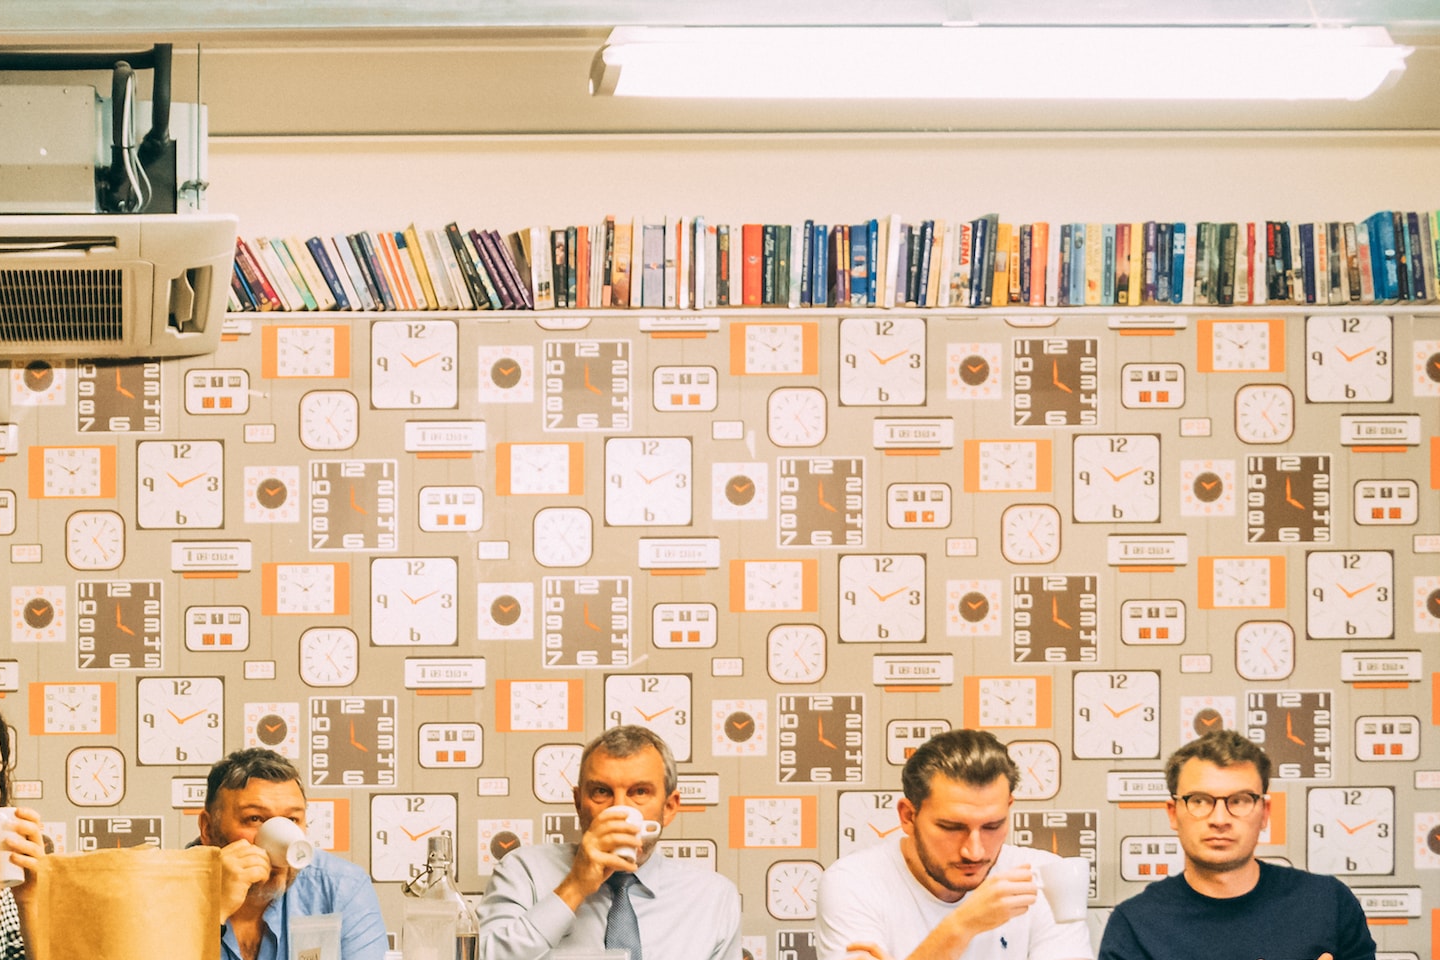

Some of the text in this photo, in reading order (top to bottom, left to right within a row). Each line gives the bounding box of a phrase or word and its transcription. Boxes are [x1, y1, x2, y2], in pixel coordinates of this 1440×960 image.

[960, 225, 971, 265] ARENA
[406, 324, 425, 338] 12
[874, 321, 893, 336] 12
[1341, 318, 1360, 332] 12
[377, 357, 388, 371] 9
[441, 356, 452, 371] 3
[845, 354, 856, 368] 9
[909, 354, 920, 368] 3
[1311, 351, 1322, 365] 9
[1376, 350, 1388, 365] 3
[172, 444, 191, 458] 12
[640, 441, 659, 456] 12
[1108, 438, 1127, 452] 12
[781, 460, 795, 474] 11
[809, 460, 832, 474] 12
[1249, 457, 1263, 471] 11
[1277, 457, 1300, 471] 12
[143, 477, 154, 491] 9
[207, 476, 218, 491] 3
[611, 474, 622, 488] 9
[675, 474, 686, 488] 3
[780, 477, 798, 491] 10
[846, 477, 861, 491] 2
[1079, 471, 1090, 485] 9
[1143, 470, 1154, 485] 3
[1248, 474, 1266, 488] 10
[1313, 474, 1328, 488] 2
[781, 495, 796, 509] 9
[846, 495, 861, 509] 3
[1249, 492, 1264, 506] 9
[1313, 492, 1328, 506] 3
[781, 513, 796, 527] 8
[845, 513, 861, 528] 4
[1249, 510, 1264, 524] 8
[1313, 510, 1329, 524] 4
[781, 530, 797, 544] 7
[810, 530, 832, 544] 6
[845, 530, 861, 544] 5
[1249, 527, 1265, 542] 7
[1278, 527, 1300, 542] 6
[1313, 527, 1329, 542] 5
[406, 561, 425, 576] 12
[874, 558, 893, 572] 12
[1341, 555, 1360, 570] 12
[1015, 577, 1029, 591] 11
[1043, 577, 1066, 591] 12
[845, 591, 856, 605] 9
[909, 590, 920, 605] 3
[1312, 588, 1323, 602] 9
[1377, 586, 1388, 601] 3
[376, 594, 387, 608] 9
[441, 594, 452, 608] 3
[1014, 594, 1032, 608] 10
[1080, 594, 1095, 608] 2
[1015, 612, 1030, 626] 9
[1080, 612, 1095, 626] 3
[1015, 630, 1030, 644] 8
[1080, 630, 1096, 644] 4
[1015, 647, 1031, 662] 7
[1044, 647, 1066, 662] 6
[1080, 647, 1096, 662] 5
[640, 678, 659, 692] 12
[1108, 674, 1127, 688] 12
[172, 681, 191, 696] 12
[313, 700, 327, 714] 11
[341, 700, 364, 714] 12
[1143, 706, 1154, 721] 3
[143, 714, 154, 728] 9
[207, 714, 218, 728] 3
[610, 710, 621, 724] 9
[675, 710, 686, 725] 3
[1079, 708, 1090, 722] 9
[312, 717, 330, 731] 10
[377, 717, 392, 731] 2
[313, 735, 328, 749] 9
[377, 735, 392, 749] 3
[313, 753, 328, 767] 8
[377, 753, 393, 768] 4
[313, 770, 329, 784] 7
[342, 770, 364, 784] 6
[377, 770, 393, 784] 5
[405, 798, 424, 812] 12
[873, 794, 892, 808] 12
[1342, 791, 1361, 806] 12
[376, 830, 387, 844] 9
[844, 828, 855, 842] 9
[1313, 824, 1324, 838] 9
[1377, 824, 1388, 838] 3
